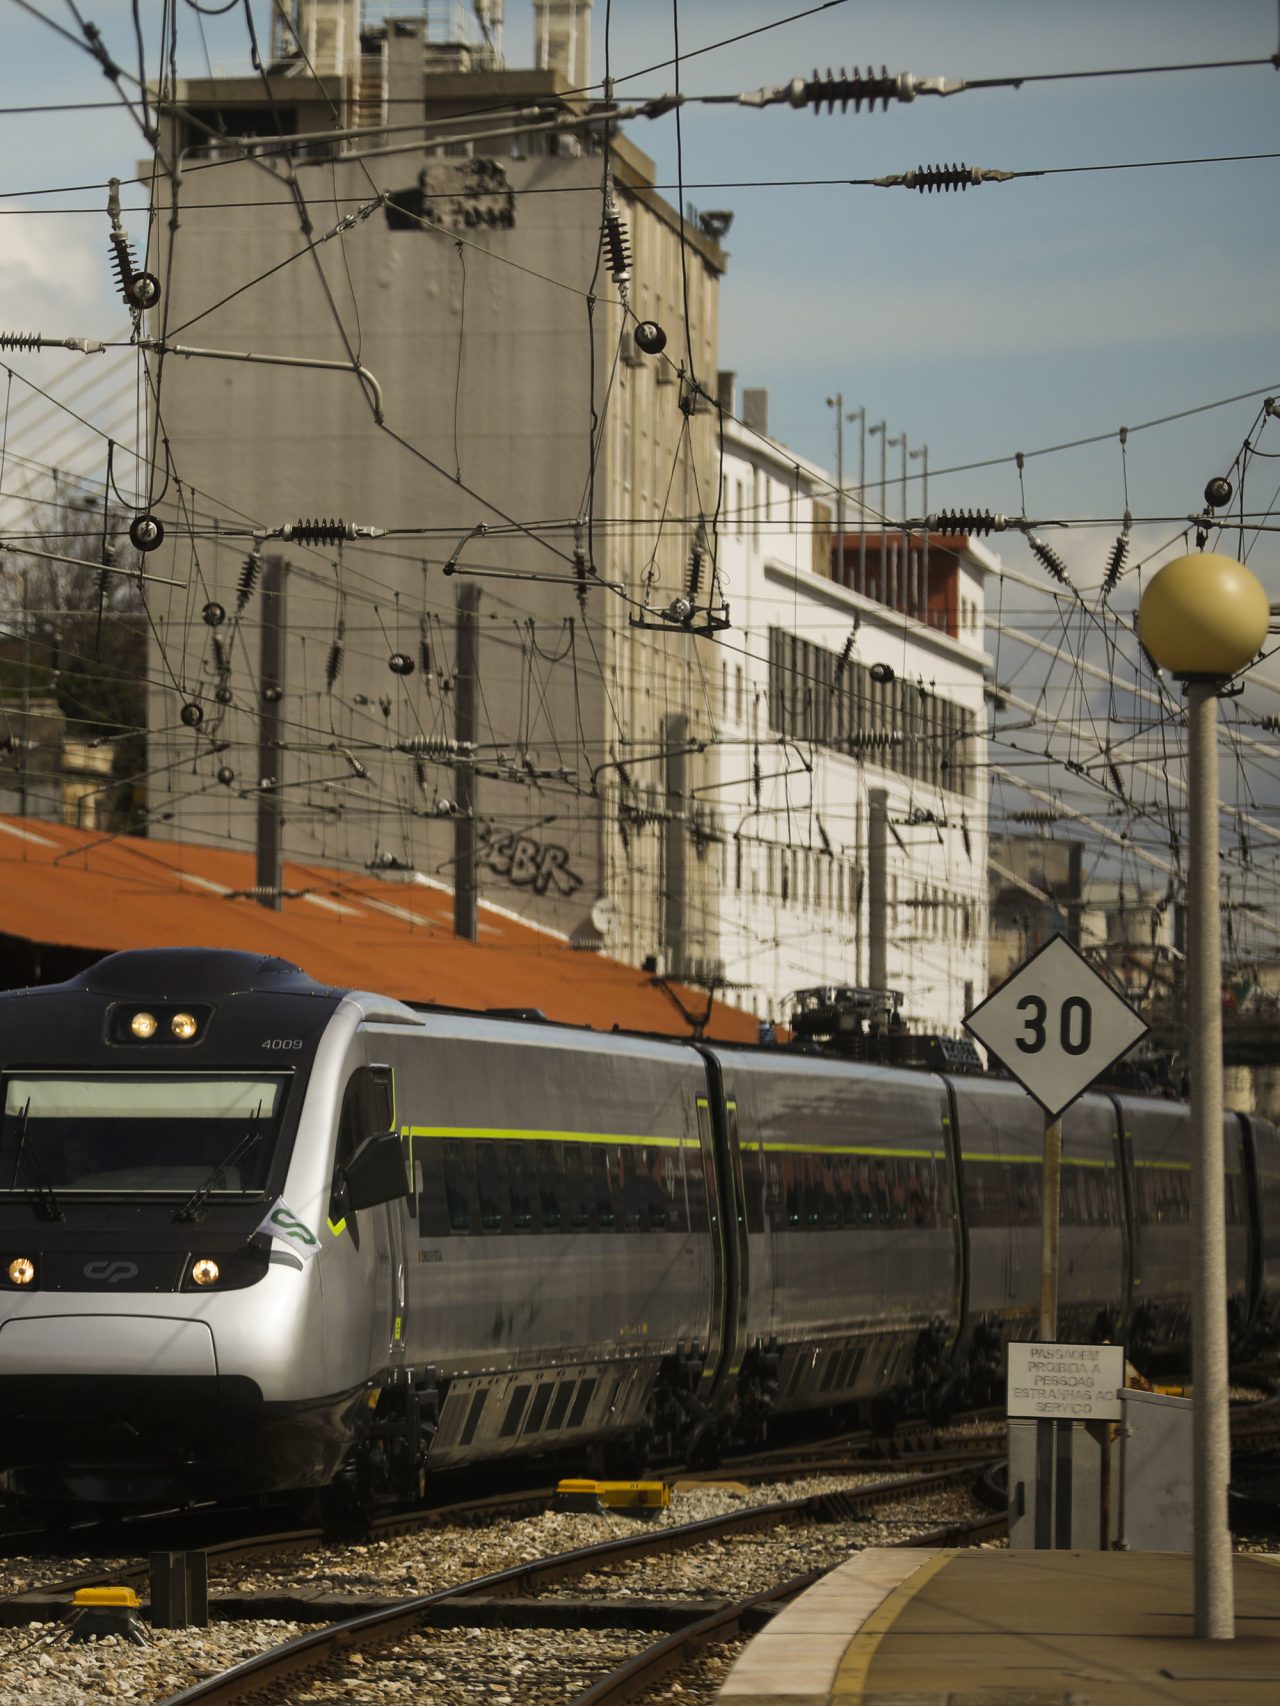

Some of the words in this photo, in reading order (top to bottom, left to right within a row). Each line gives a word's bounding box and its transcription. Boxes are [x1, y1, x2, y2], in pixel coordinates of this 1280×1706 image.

[1015, 994, 1093, 1056] 30
[261, 1039, 303, 1050] 4009
[83, 1261, 139, 1283] CP
[1092, 1364, 1101, 1374] A
[1034, 1374, 1096, 1388] PESSOAS
[1013, 1387, 1093, 1401] ESTRANHAS
[1095, 1390, 1114, 1401] AO
